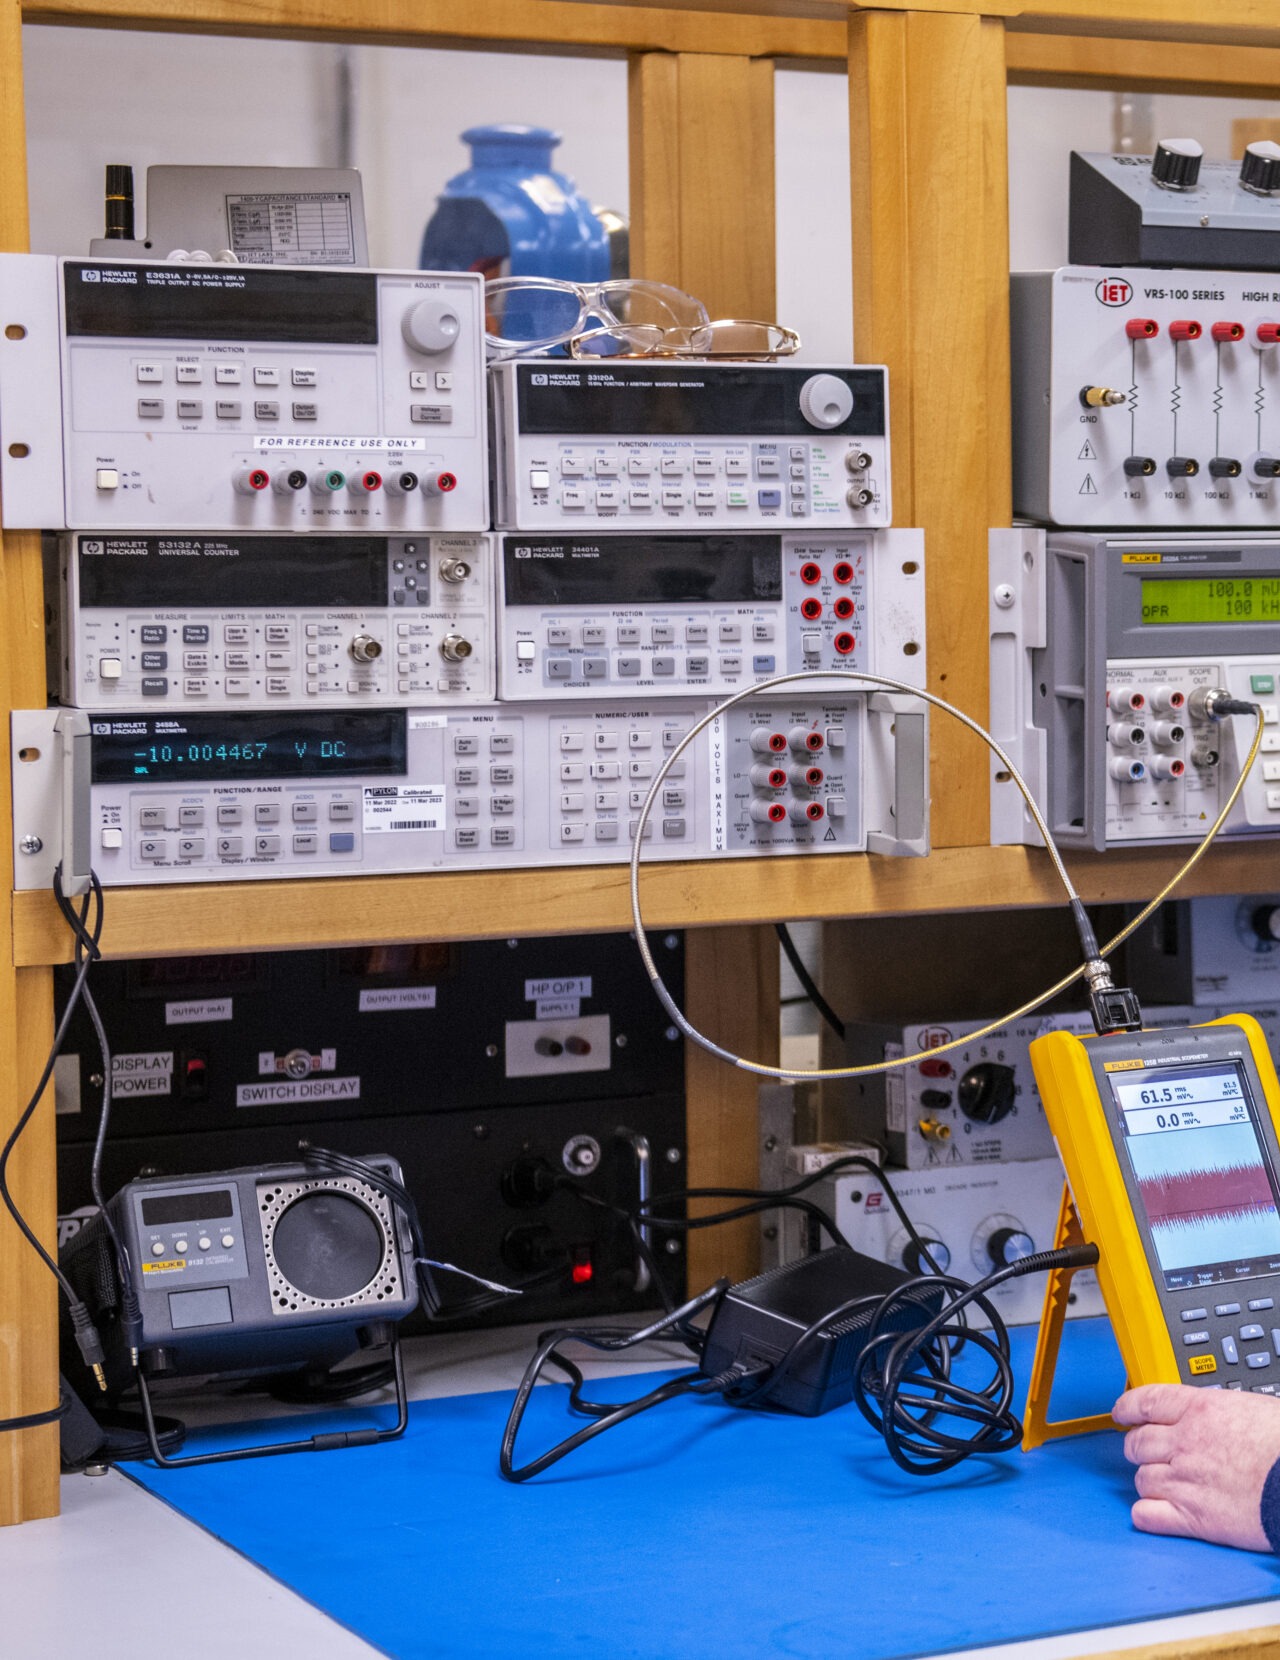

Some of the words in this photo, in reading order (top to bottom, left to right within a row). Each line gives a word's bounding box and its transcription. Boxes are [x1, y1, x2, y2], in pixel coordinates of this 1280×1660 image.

[102, 270, 138, 278] HEWLETT
[1144, 288, 1190, 300] VRS-100
[1192, 290, 1225, 301] SERIES
[1242, 291, 1270, 302] HIGH
[208, 346, 245, 354] FUNCTION
[1080, 416, 1098, 424] GND
[260, 438, 284, 447] FOR
[288, 438, 356, 448] REFERENCE
[360, 439, 383, 448] USE
[388, 440, 418, 448] ONLY
[1164, 492, 1173, 500] 10
[1204, 492, 1217, 500] 100
[106, 548, 149, 556] PACKARD
[1208, 581, 1253, 598] 100.0
[1142, 605, 1170, 618] OPR
[1226, 600, 1253, 616] 100
[1188, 668, 1212, 676] SCOPE
[144, 680, 164, 688] Recall
[1192, 677, 1208, 685] OUT
[564, 736, 570, 744] 7
[598, 735, 605, 743] 8
[632, 734, 639, 742] 9
[666, 733, 672, 741] E
[134, 742, 268, 763] -10.004467
[295, 742, 308, 758] V
[320, 741, 346, 758] DC
[564, 766, 571, 774] 4
[632, 764, 639, 772] 6
[214, 786, 283, 794] FUNCTION/RANGE
[373, 787, 398, 797] PYLON
[564, 797, 570, 805] 1
[598, 796, 605, 804] 2
[633, 794, 639, 802] 3
[564, 827, 571, 835] 0
[532, 982, 550, 995] HP
[552, 980, 576, 995] O/P
[366, 994, 397, 1005] OUTPUT
[171, 1007, 204, 1018] OUTPUT
[206, 1004, 226, 1017] (mA)
[981, 1048, 988, 1058] 5
[998, 1050, 1005, 1060] 6
[111, 1056, 172, 1073] DISPLAY
[1112, 1061, 1142, 1070] FLUKE
[1158, 1056, 1182, 1065] INDUSTRIAL
[1182, 1054, 1209, 1063] SCOPEMETER
[114, 1076, 168, 1093] POWER
[242, 1086, 297, 1101] SWITCH
[299, 1081, 358, 1098] DISPLAY
[1140, 1087, 1174, 1106] 61.5
[1156, 1113, 1180, 1128] 0.0
[150, 1261, 184, 1270] FLUKE
[1170, 1276, 1183, 1284] Move
[1197, 1272, 1214, 1280] Trigger
[1194, 1356, 1213, 1365] SCOPE
[1196, 1362, 1215, 1371] METER
[1260, 1385, 1276, 1394] TIME
